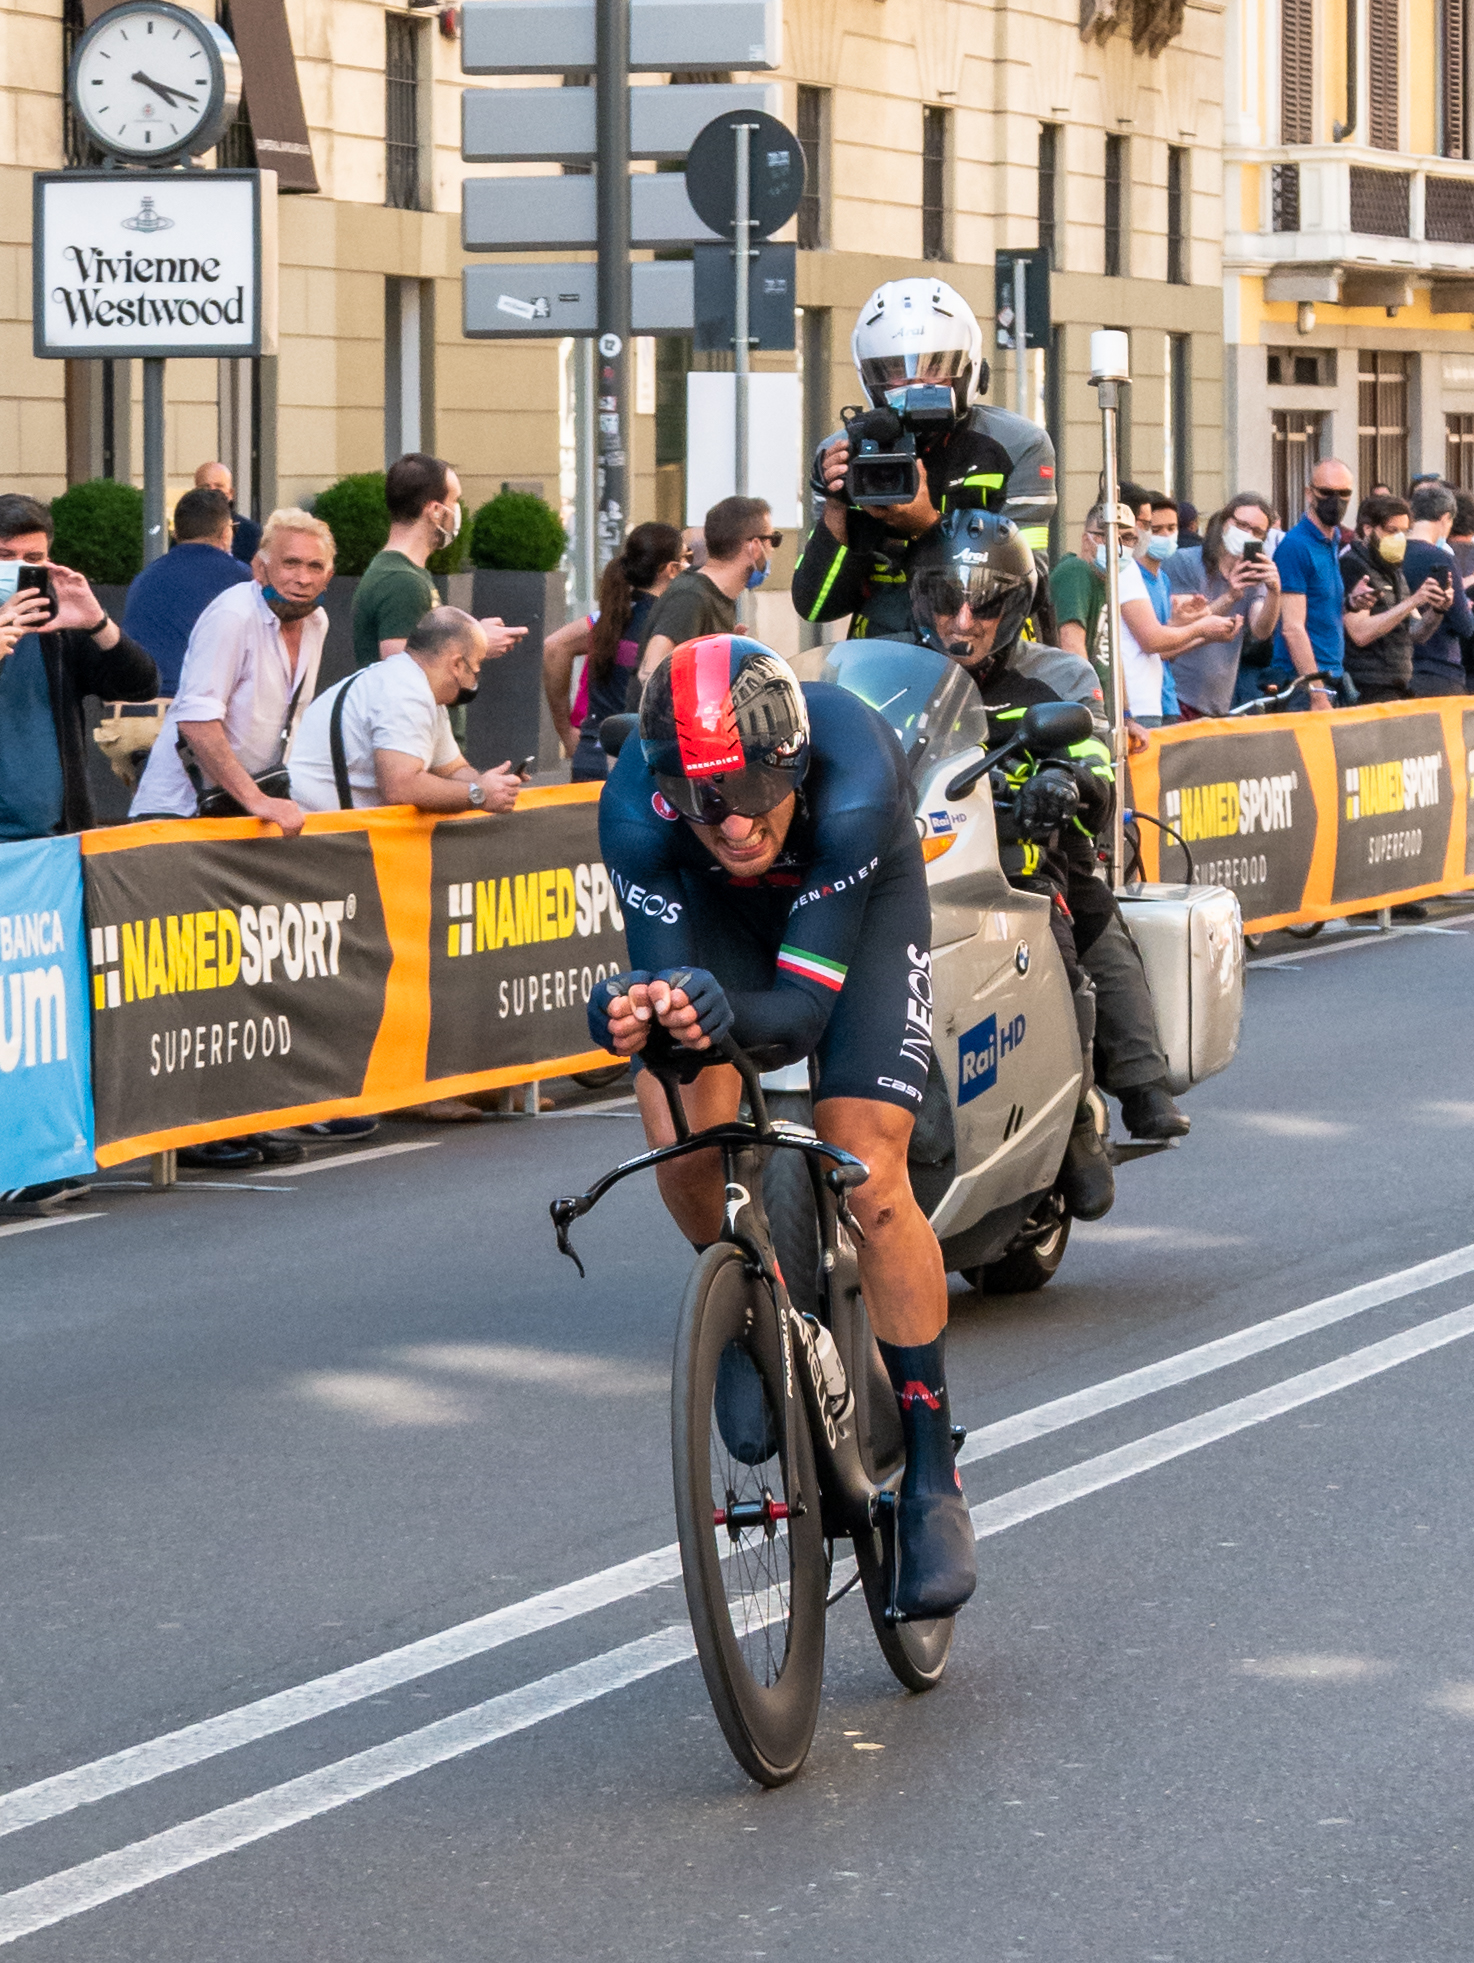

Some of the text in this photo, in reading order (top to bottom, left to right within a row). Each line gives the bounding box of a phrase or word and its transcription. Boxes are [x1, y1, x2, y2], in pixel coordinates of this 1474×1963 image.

[63, 245, 221, 284] Vivienne
[51, 285, 245, 330] Westwood
[891, 324, 925, 339] Arai
[952, 547, 989, 562] Arai
[686, 755, 740, 771] GRENADIER
[1360, 756, 1439, 817] NAMEDSPORT
[951, 812, 967, 824] HD
[1181, 773, 1294, 842] NAMEDSPORT
[1369, 828, 1422, 864] SUPERFOOD
[788, 856, 879, 917] RENADIER
[1193, 854, 1268, 887] SUPERFOOD
[610, 868, 683, 925] INEOS
[0, 910, 64, 961] BANCA
[899, 943, 934, 1074] INEOS
[150, 1015, 292, 1077] SUPERFOOD
[962, 1013, 1026, 1086] Rai HD
